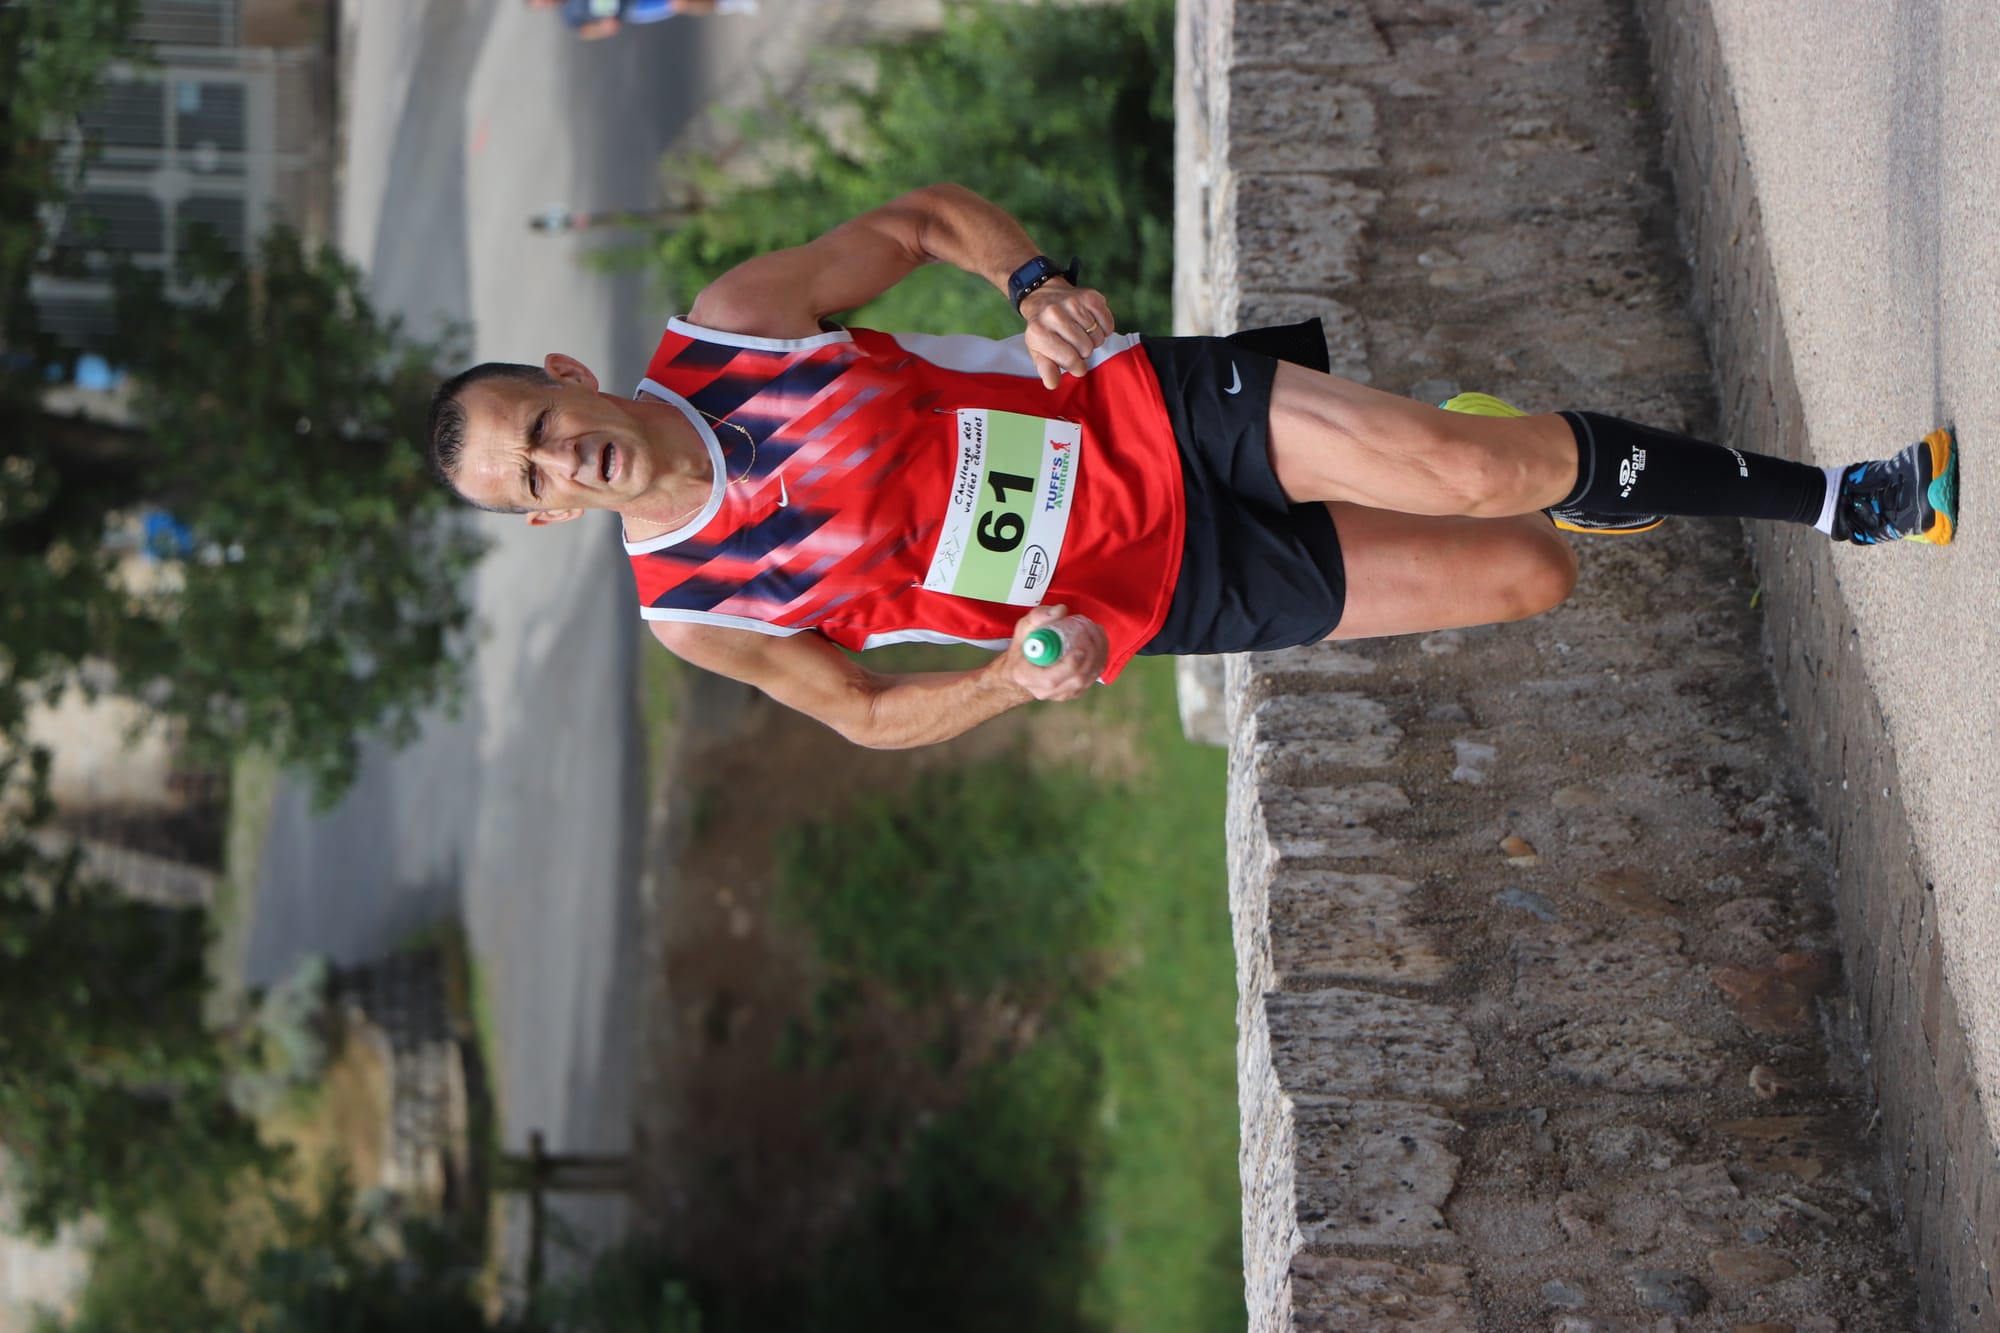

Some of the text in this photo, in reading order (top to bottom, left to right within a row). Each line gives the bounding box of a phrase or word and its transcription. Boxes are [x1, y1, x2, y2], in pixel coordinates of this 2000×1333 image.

[955, 421, 973, 505] Challenge des
[1045, 457, 1062, 512] TUFF'S
[1054, 452, 1071, 508] Aventure
[1629, 445, 1640, 485] SPORT
[977, 471, 1035, 552] 61
[1024, 552, 1042, 589] BFP
